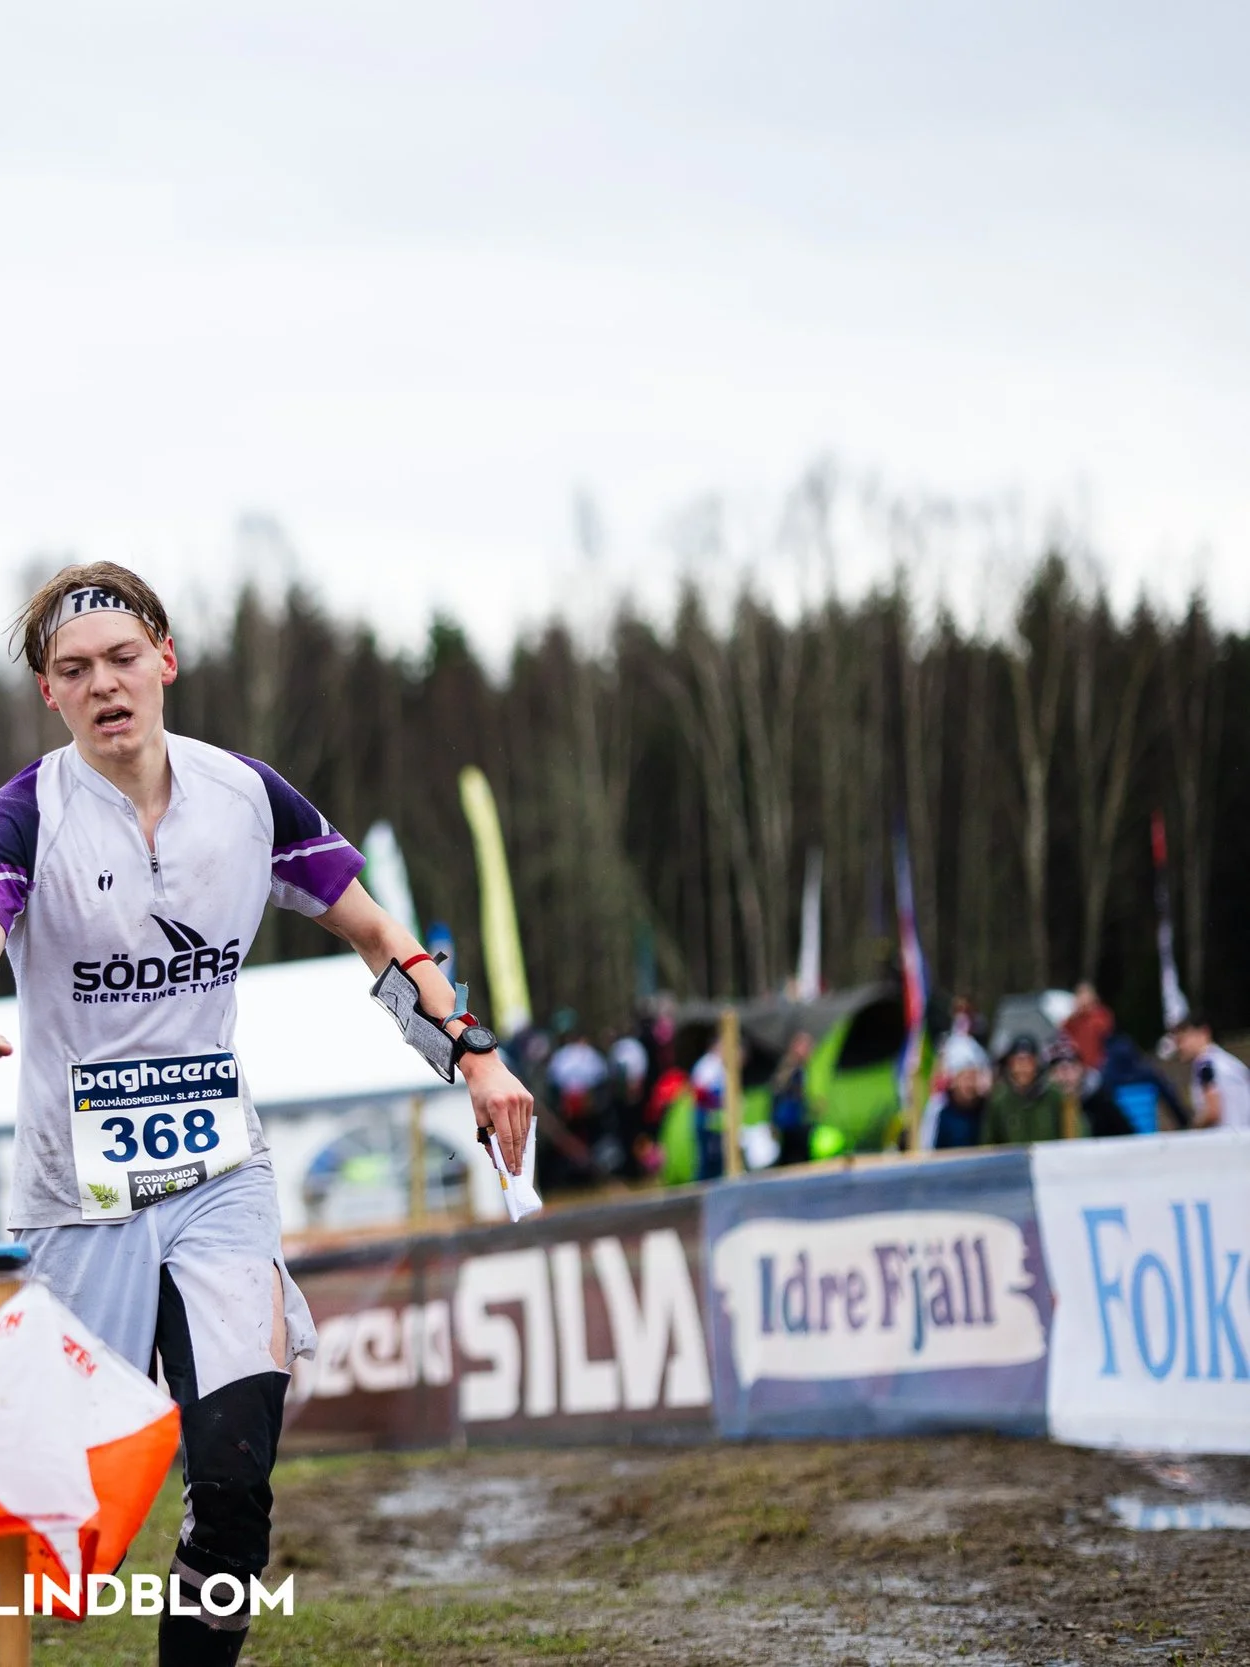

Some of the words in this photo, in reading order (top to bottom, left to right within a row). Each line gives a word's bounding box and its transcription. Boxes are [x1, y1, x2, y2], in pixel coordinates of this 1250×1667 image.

[72, 986, 177, 1004] ORIENTERING
[189, 971, 238, 994] TYRESÖ
[73, 938, 240, 992] SÖDERS
[74, 1059, 237, 1093] bagheera
[90, 1093, 170, 1108] KOLMÅRDSMEDELN
[176, 1092, 188, 1101] SL
[188, 1090, 200, 1100] #2
[201, 1088, 223, 1098] 2026
[100, 1108, 220, 1163] 368
[134, 1167, 199, 1185] GODKÄNDA
[759, 1249, 868, 1335] Idre
[873, 1235, 997, 1353] Fjäll
[1082, 1202, 1250, 1382] Folk
[456, 1228, 713, 1422] SILVA
